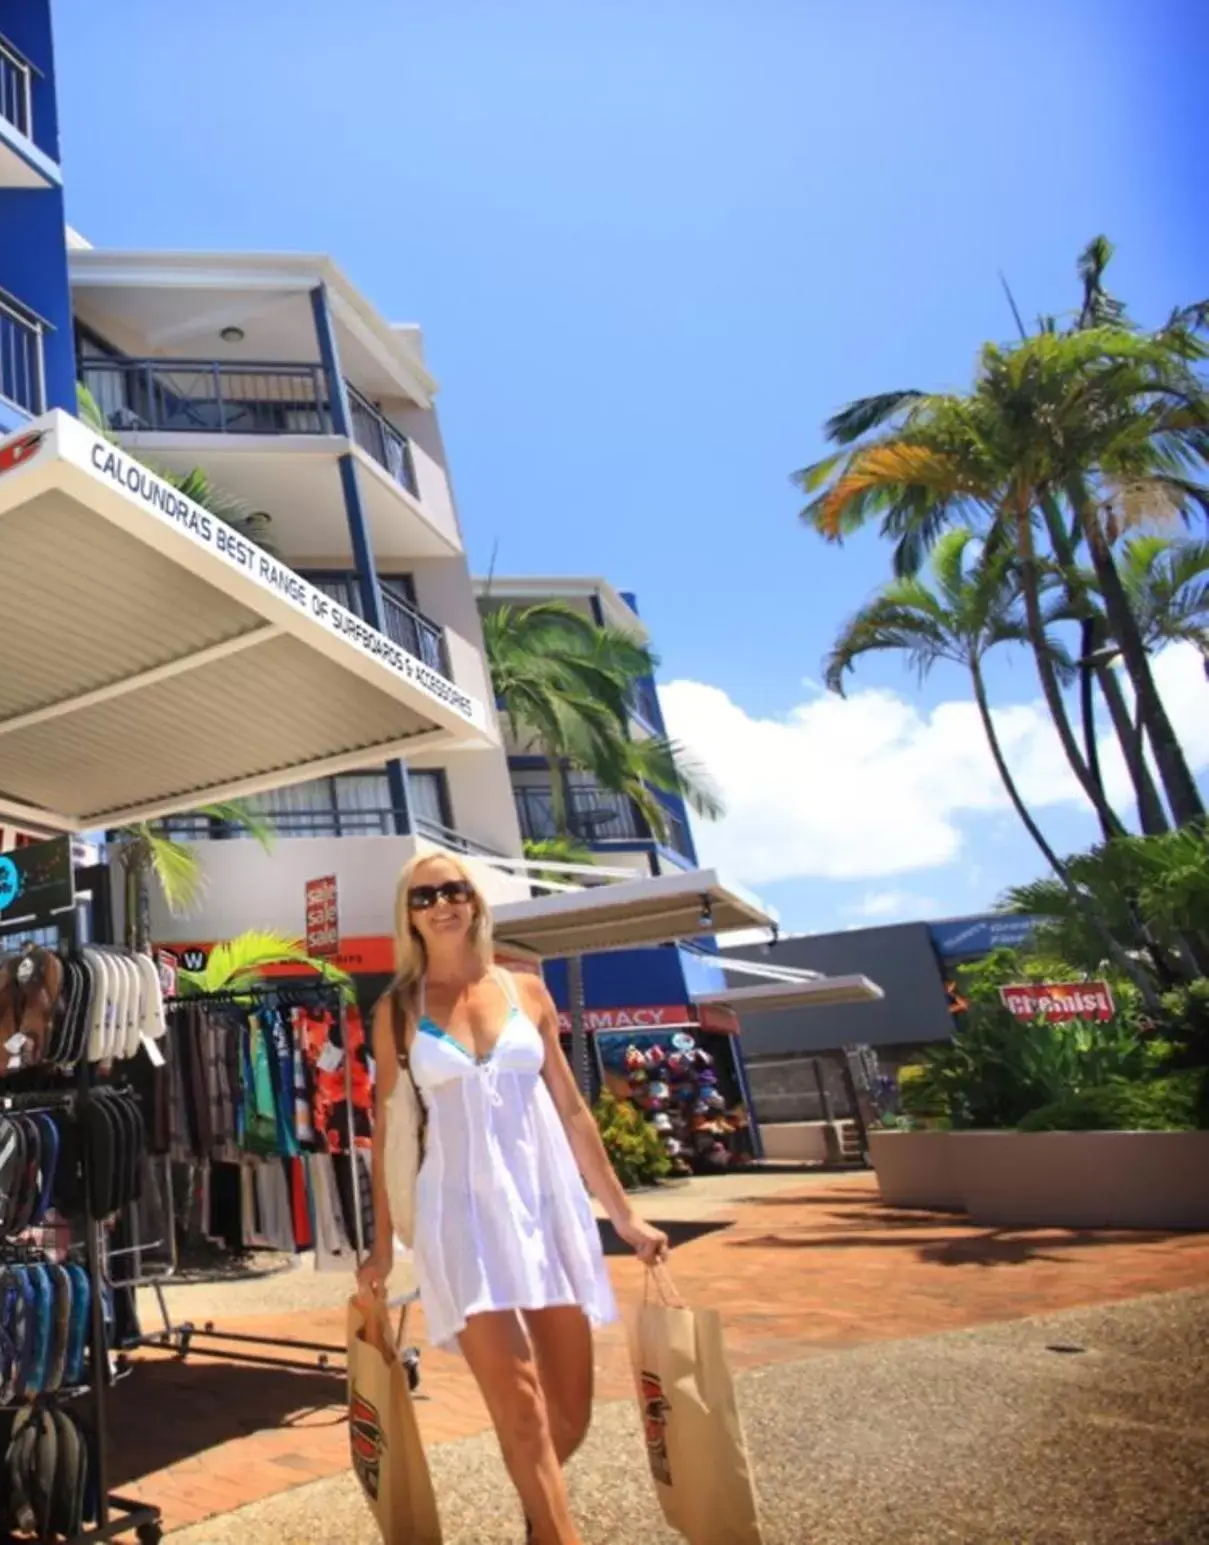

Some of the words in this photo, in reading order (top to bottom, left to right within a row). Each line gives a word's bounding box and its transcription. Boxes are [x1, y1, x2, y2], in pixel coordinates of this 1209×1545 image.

[216, 527, 255, 571] BEST
[259, 556, 307, 607] RANGE
[312, 594, 329, 618] OF
[331, 607, 404, 672] SURFBOARDS
[307, 902, 337, 925] sale
